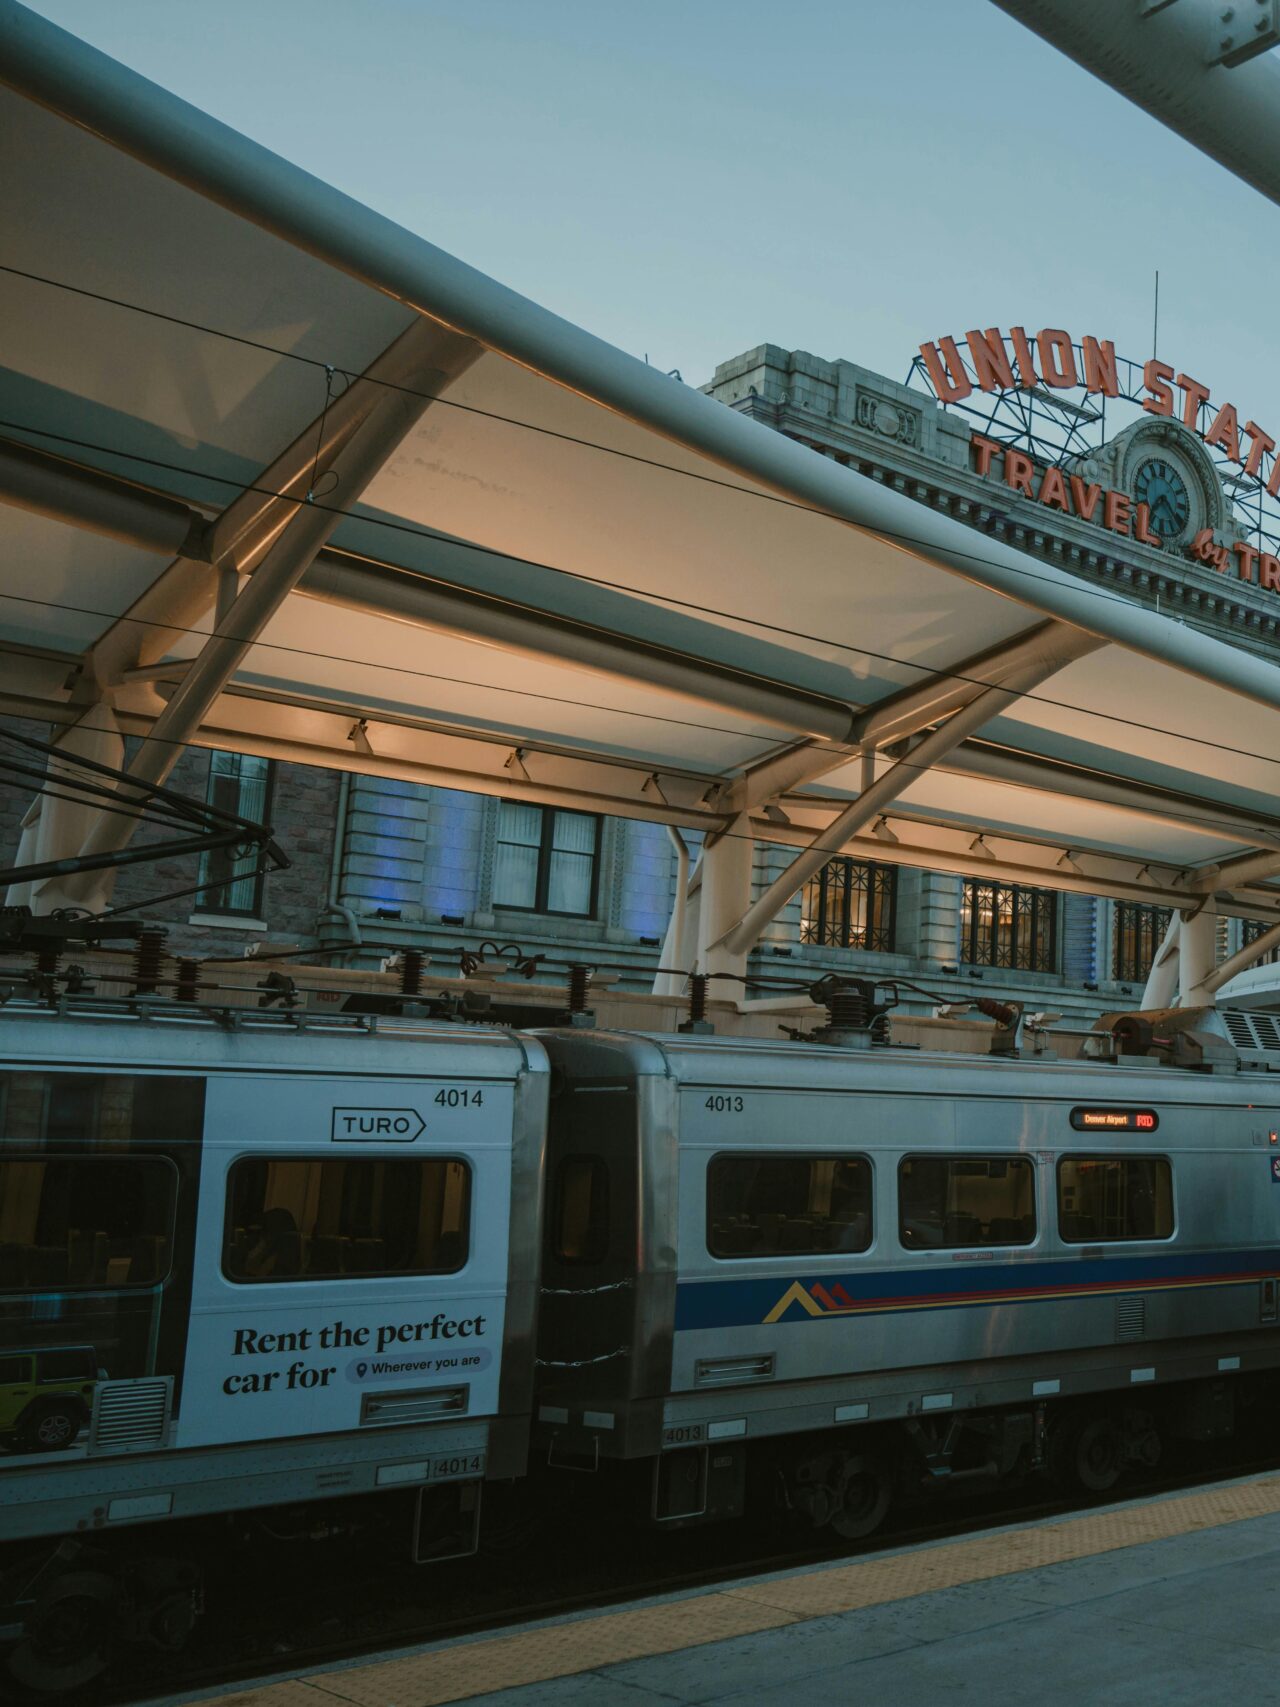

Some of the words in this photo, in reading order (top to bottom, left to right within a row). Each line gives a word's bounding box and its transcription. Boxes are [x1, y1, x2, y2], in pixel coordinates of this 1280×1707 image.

[919, 326, 1120, 404] UNION
[970, 434, 1162, 547] TRAVEL
[1189, 526, 1231, 574] by
[434, 1088, 484, 1108] 4014
[704, 1095, 744, 1112] 4013
[343, 1117, 410, 1133] TURO
[1084, 1114, 1106, 1124] Denver
[1106, 1114, 1128, 1125] Airport
[1136, 1114, 1154, 1127] RTD
[231, 1327, 313, 1355] Rent
[319, 1320, 370, 1350] the
[375, 1313, 487, 1354] perfect
[371, 1360, 433, 1375] Wherever
[435, 1358, 458, 1371] you
[461, 1355, 481, 1367] are
[222, 1370, 281, 1395] car
[286, 1361, 337, 1390] for
[666, 1425, 701, 1442] 4013
[438, 1456, 481, 1475] 4014
